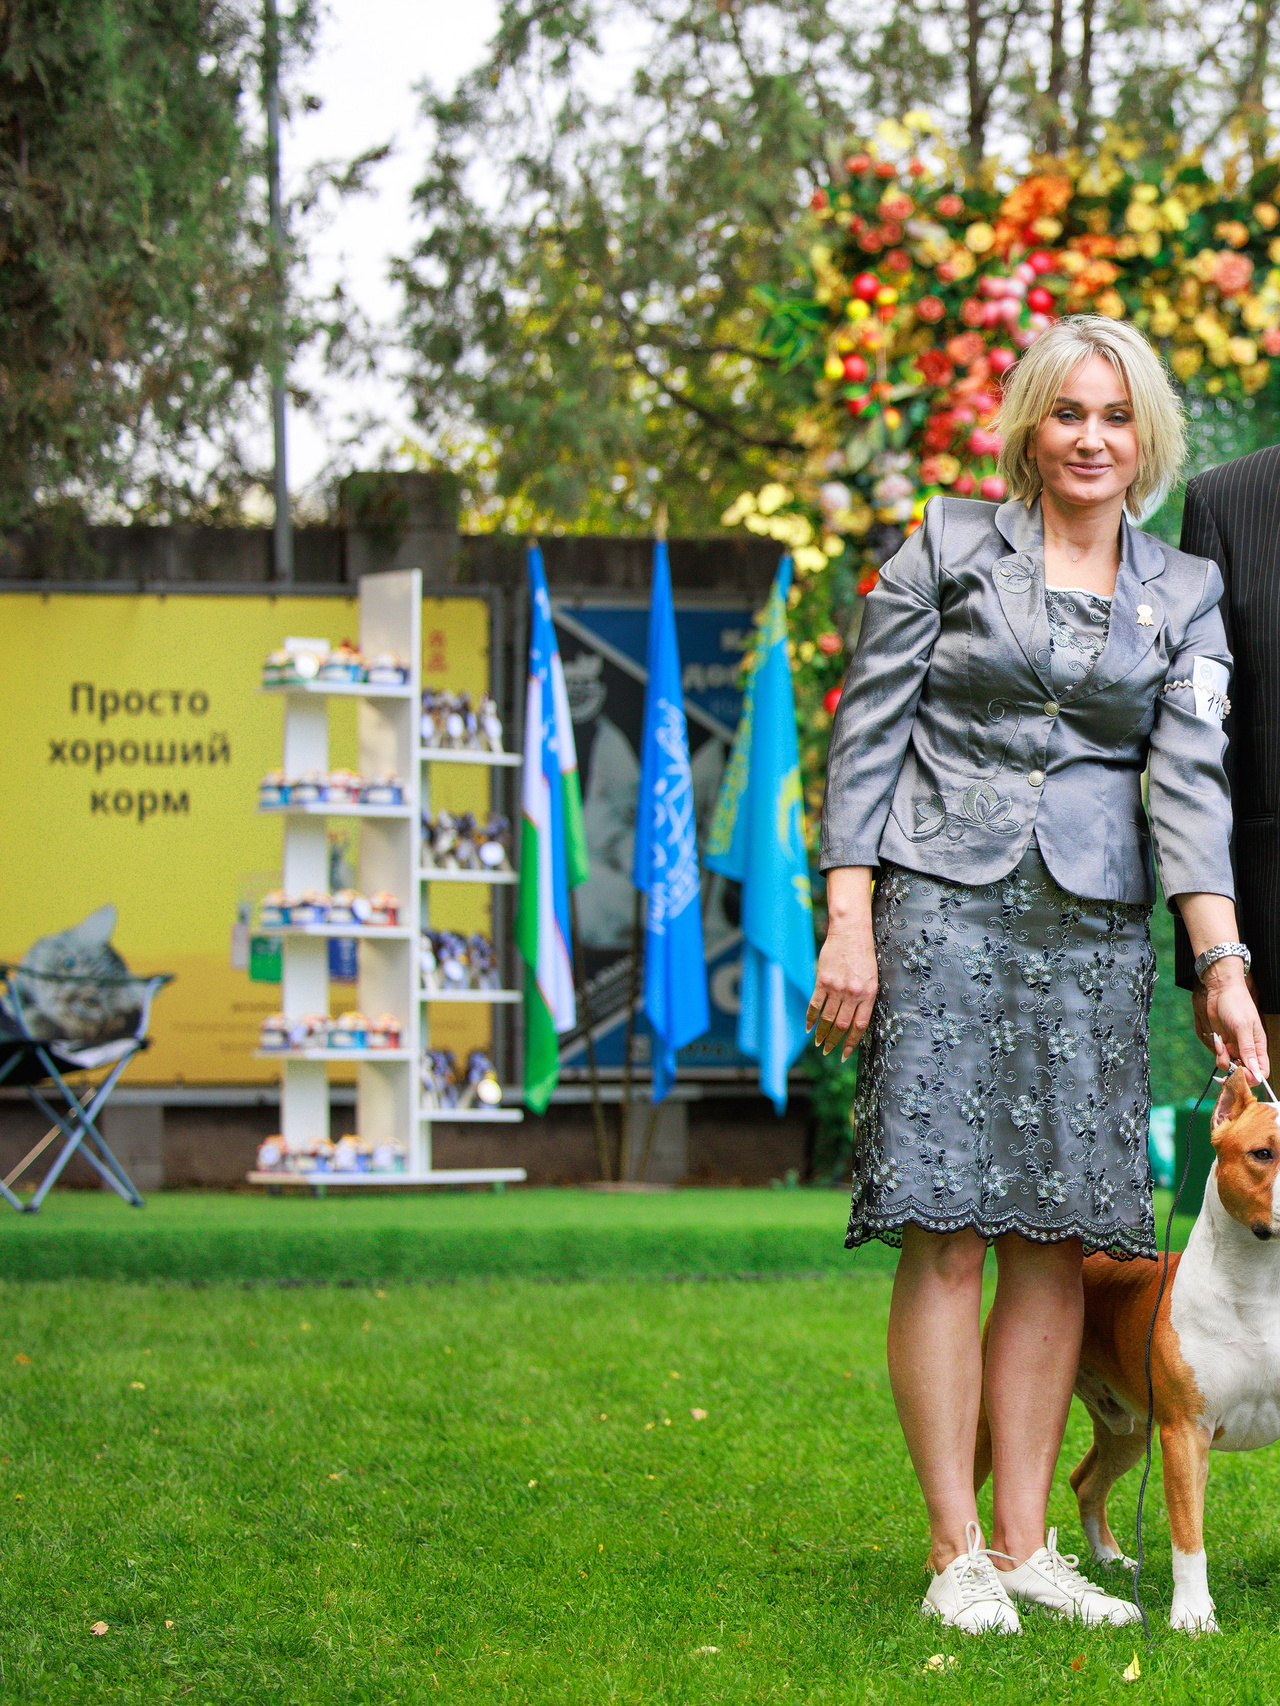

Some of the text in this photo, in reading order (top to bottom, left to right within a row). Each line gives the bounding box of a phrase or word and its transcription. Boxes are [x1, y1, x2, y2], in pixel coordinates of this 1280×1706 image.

[70, 682, 210, 724] Просто
[49, 731, 231, 774] хороший
[90, 789, 190, 825] корм
